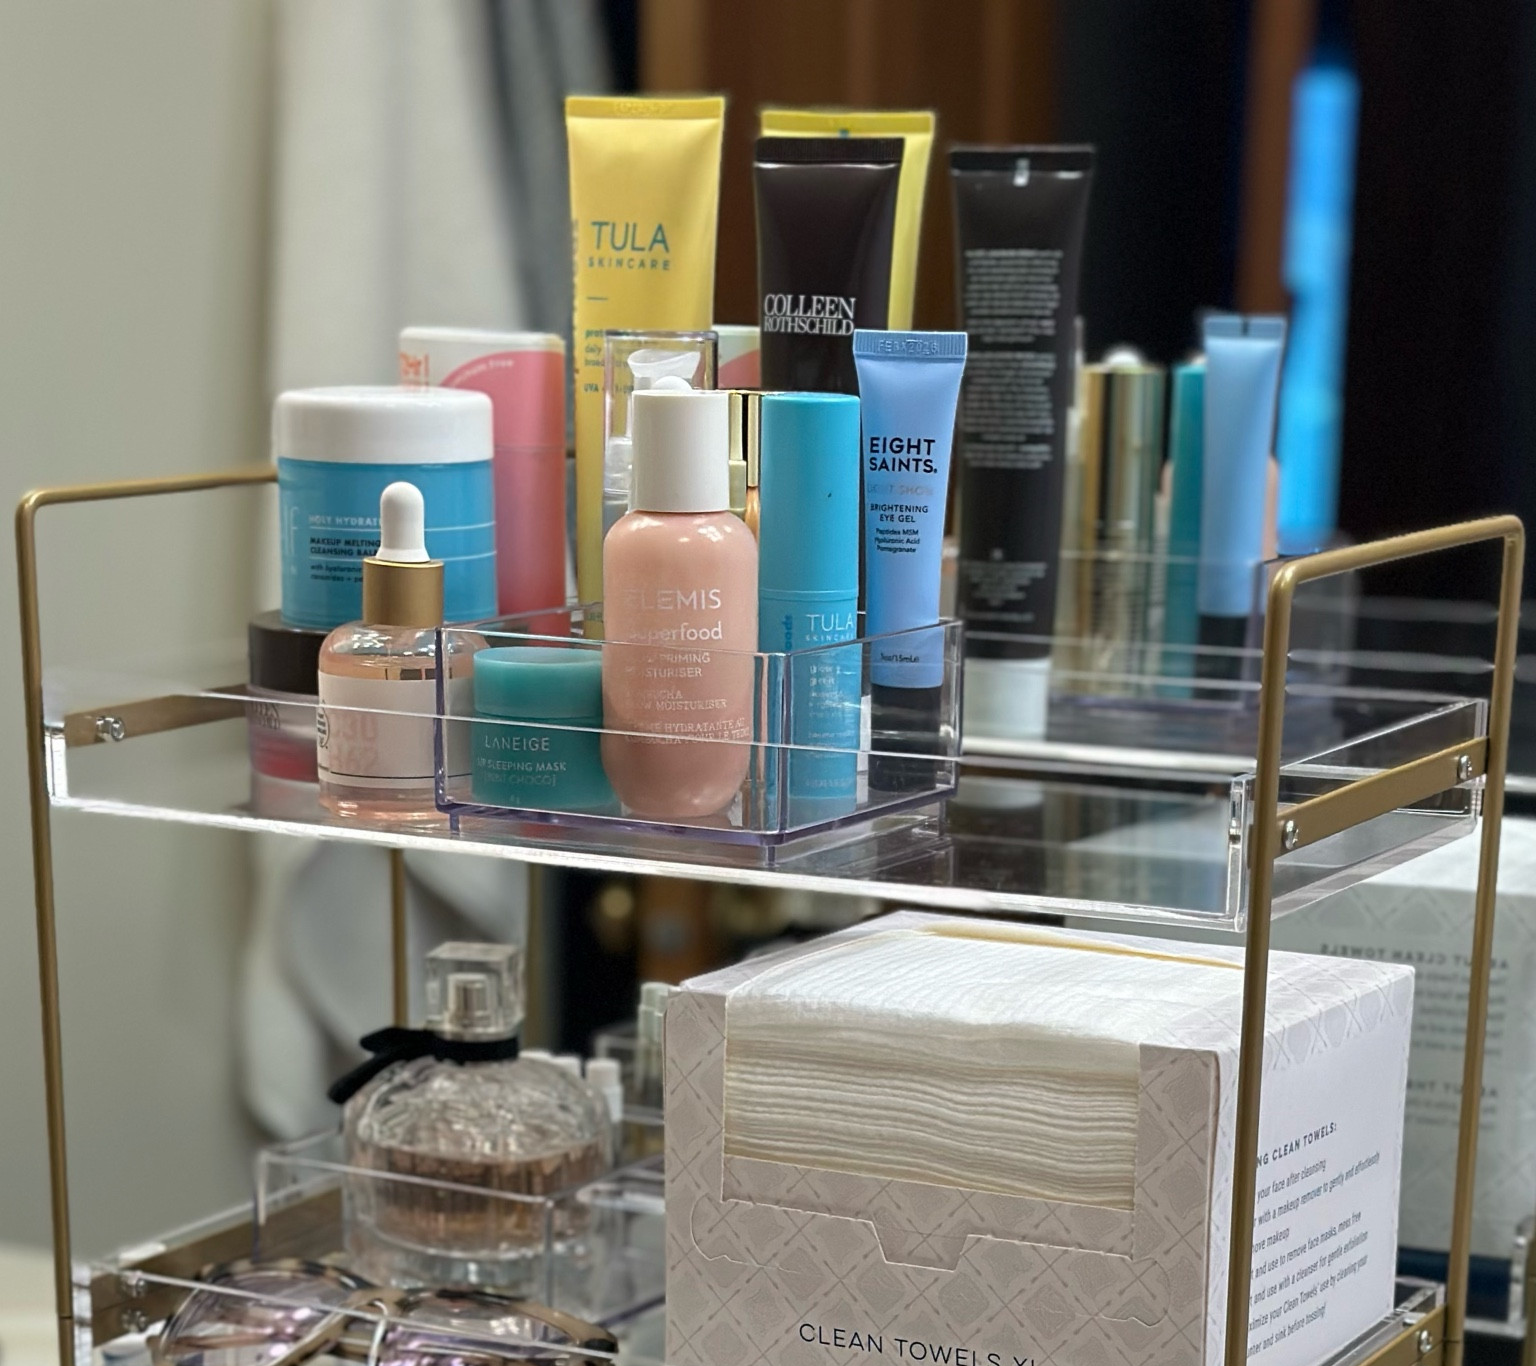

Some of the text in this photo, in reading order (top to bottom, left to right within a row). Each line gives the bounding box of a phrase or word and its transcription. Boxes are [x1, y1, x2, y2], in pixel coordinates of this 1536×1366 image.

[591, 221, 670, 253] TULA
[588, 257, 671, 271] SKINCARE
[764, 294, 856, 319] COLLEEN
[764, 317, 855, 336] ROTHSCHILD
[869, 437, 936, 456] EIGHT
[869, 457, 938, 473] SAINTS.
[870, 503, 929, 513] BRIGHTENING
[336, 517, 381, 526] HYDRAT
[880, 514, 916, 523] EYE GEL
[310, 537, 341, 545] MAKEUP
[877, 545, 916, 553] Pomegranate
[310, 547, 353, 556] CLEANSING
[805, 613, 856, 631] TULA
[656, 699, 728, 711] MOISTURISER
[485, 735, 550, 751] LANEIGE
[487, 760, 533, 771] SLEEPING
[536, 761, 567, 771] MASK
[1271, 1139, 1301, 1161] CLEAN
[1303, 1122, 1337, 1147] TOWELS:
[1272, 1180, 1285, 1193] face
[1286, 1172, 1300, 1187] after
[1301, 1159, 1326, 1180] cleansing
[1258, 1209, 1271, 1225] with
[1278, 1198, 1300, 1216] makeup
[1267, 1228, 1290, 1247] makeup
[1255, 1261, 1266, 1279] and
[1268, 1258, 1278, 1272] use
[1280, 1254, 1285, 1265] to
[1287, 1243, 1306, 1262] remove
[1254, 1287, 1265, 1304] and
[1267, 1284, 1277, 1297] use
[1296, 1260, 1319, 1282] cleanser
[1269, 1306, 1282, 1324] your
[1283, 1297, 1299, 1314] Clean
[1320, 1279, 1330, 1293] use
[799, 1323, 883, 1354] CLEAN
[1263, 1333, 1274, 1350] and
[1275, 1328, 1287, 1344] sink
